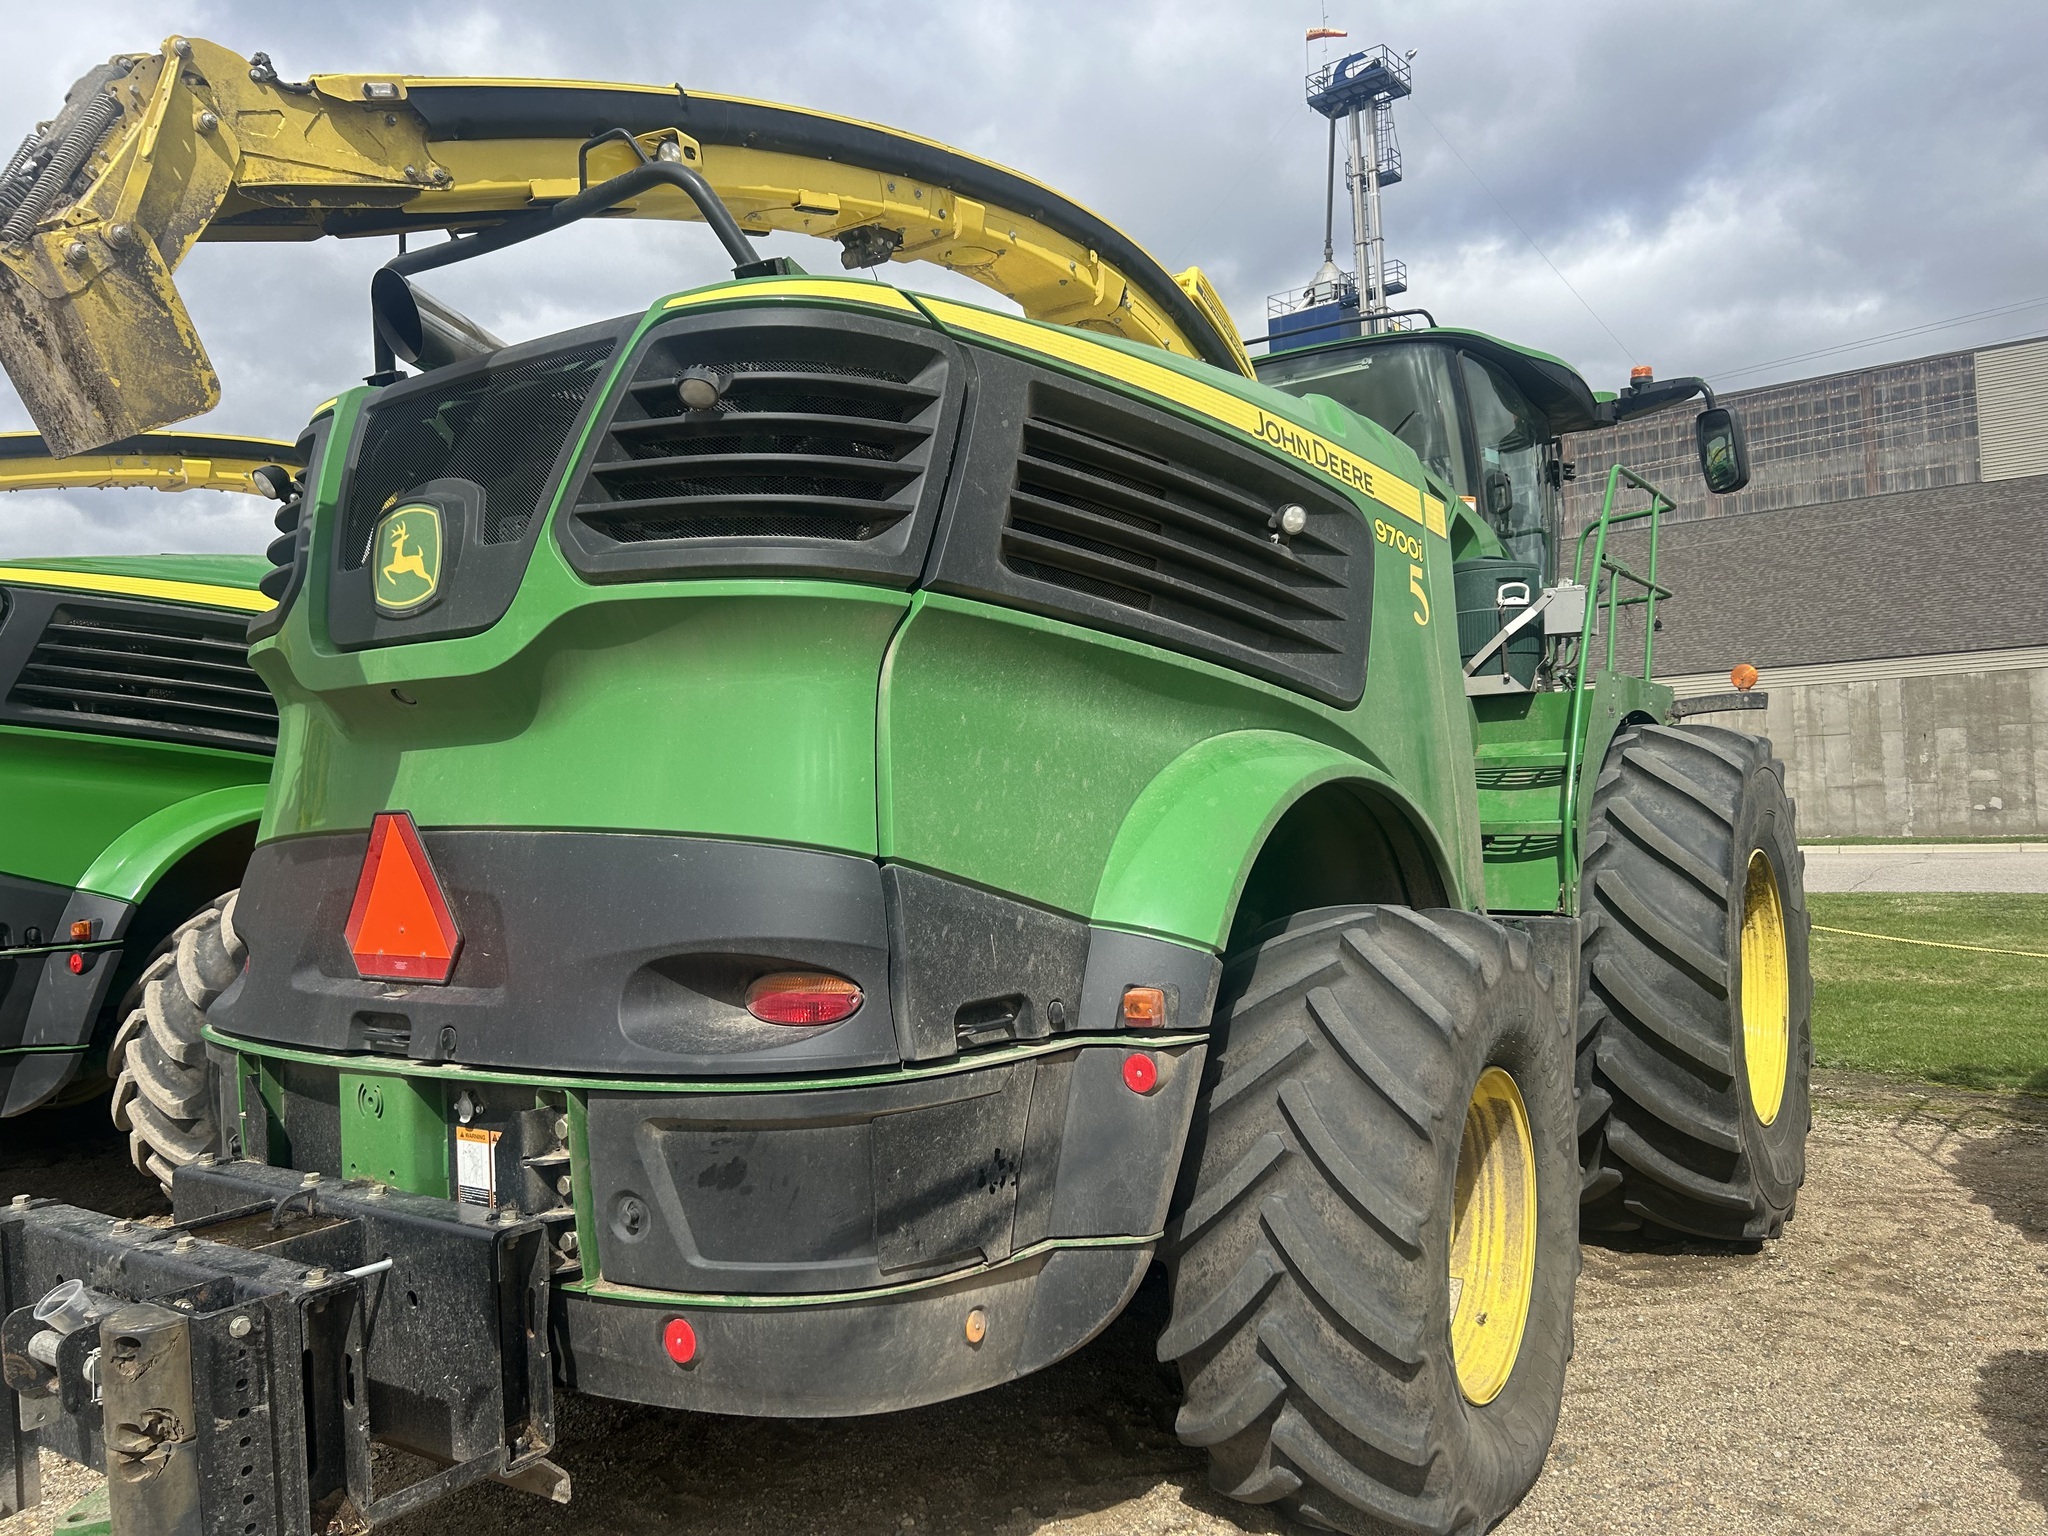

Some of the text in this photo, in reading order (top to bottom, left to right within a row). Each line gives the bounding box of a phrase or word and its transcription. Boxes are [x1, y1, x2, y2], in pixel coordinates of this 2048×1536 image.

[1254, 411, 1375, 495] JOHN DEERE
[1374, 518, 1424, 562] 9700i
[1409, 563, 1430, 626] 5
